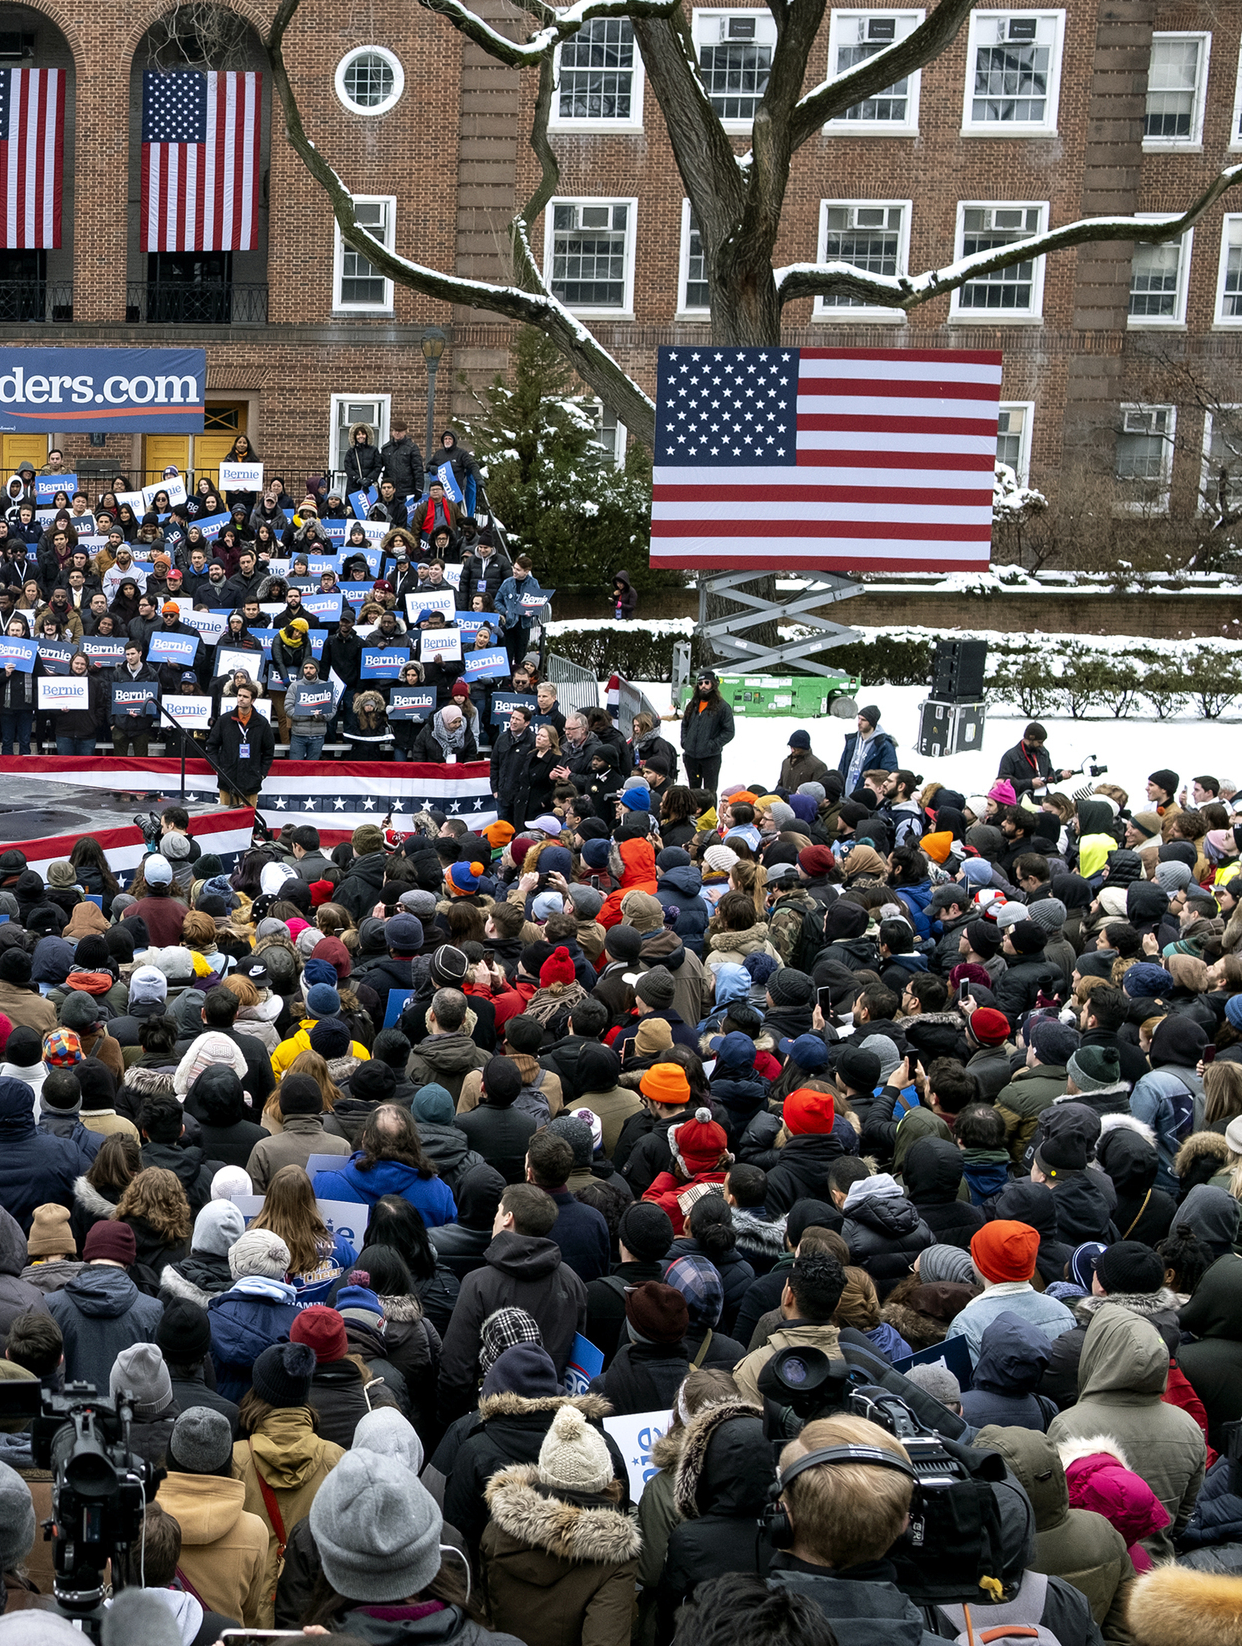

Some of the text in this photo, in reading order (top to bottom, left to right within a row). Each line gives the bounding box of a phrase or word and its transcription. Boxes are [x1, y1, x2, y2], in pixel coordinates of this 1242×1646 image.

[223, 469, 260, 480] Bernie
[39, 482, 75, 493] Bernie
[437, 466, 456, 501] Bernie
[410, 598, 451, 612] Bernie
[521, 591, 549, 606] Bernie
[182, 617, 222, 632] Bernie
[83, 641, 125, 654] Bernie
[153, 639, 194, 654] Bernie
[423, 635, 457, 648] Bernie
[365, 654, 406, 667] Bernie
[464, 653, 505, 670] Bernie
[42, 684, 84, 696] Bernie
[115, 689, 154, 701] Bernie
[300, 690, 332, 703] Bernie
[394, 693, 433, 706] Bernie
[167, 703, 208, 715] Bernie
